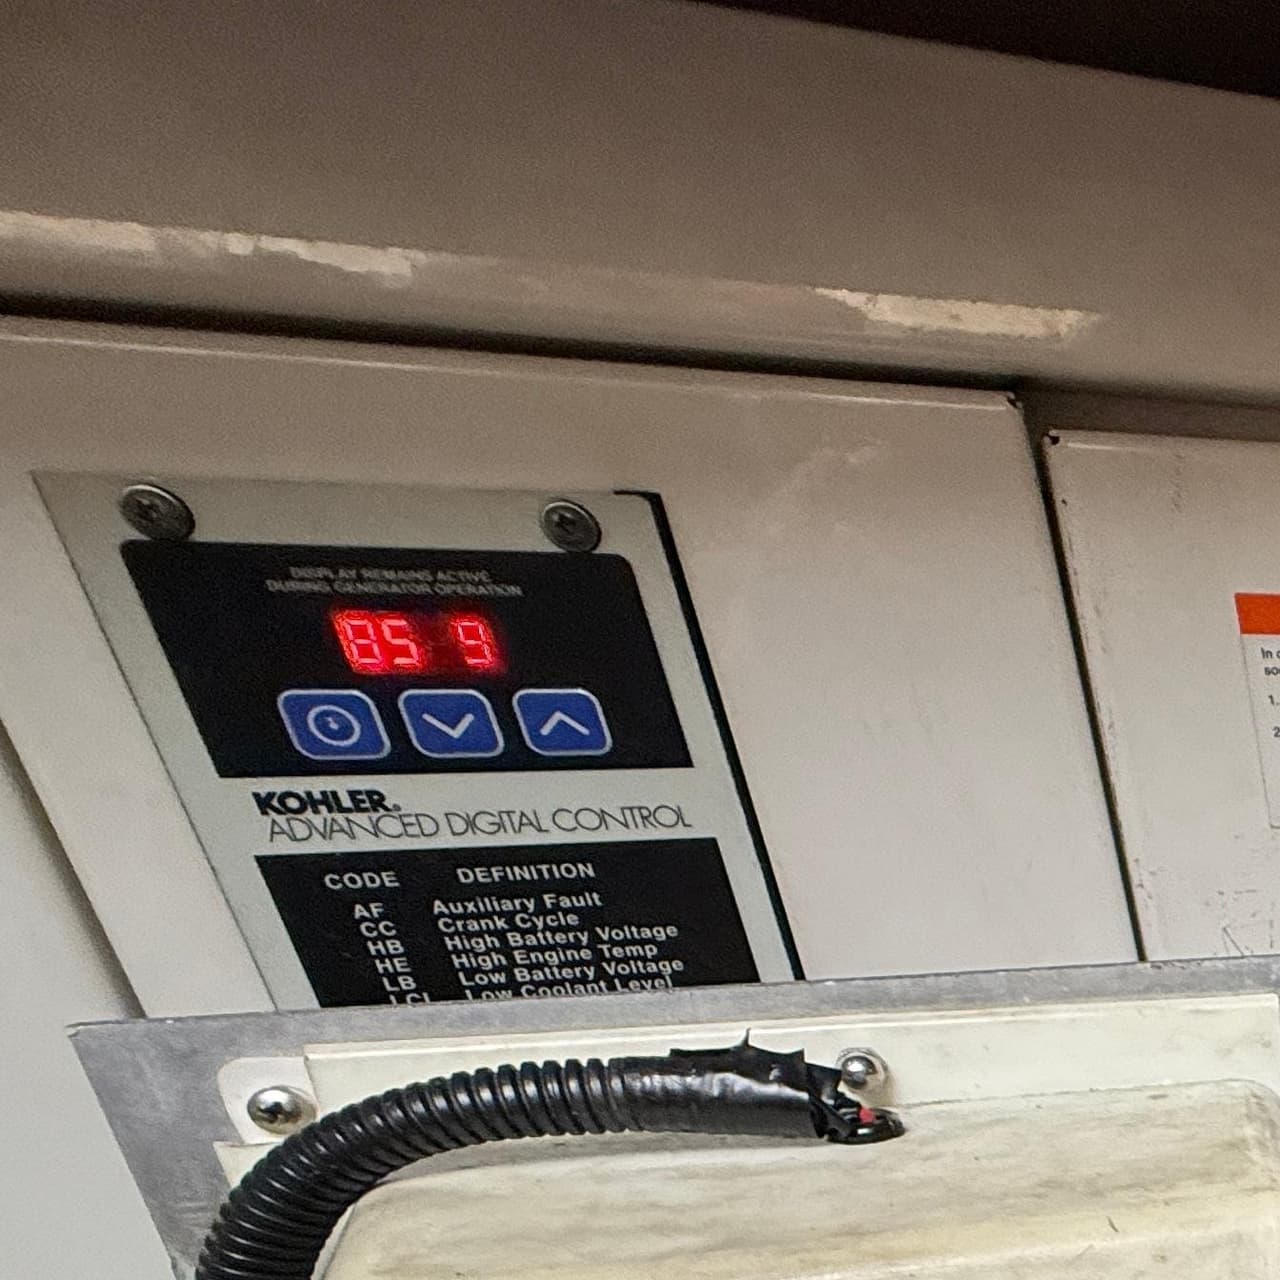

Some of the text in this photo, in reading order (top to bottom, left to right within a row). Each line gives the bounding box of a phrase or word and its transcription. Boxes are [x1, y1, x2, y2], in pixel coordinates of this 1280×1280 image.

[1261, 648, 1273, 660] In
[1268, 694, 1280, 706] 1.
[252, 789, 393, 817] KOHLER
[269, 805, 693, 843] ADVANCED DIGITAL CONTROL
[324, 862, 597, 890] CODE DEFINITION
[354, 891, 603, 920] AF Auxiliary Fault
[360, 911, 580, 938] CC Crank Cycle
[366, 924, 680, 956] HB High Battery Voltage
[375, 943, 658, 974] HE High Engine Temp
[382, 959, 685, 992] LB Low Battery Voltage
[520, 980, 610, 999] Coolant
[614, 975, 674, 992] Level
